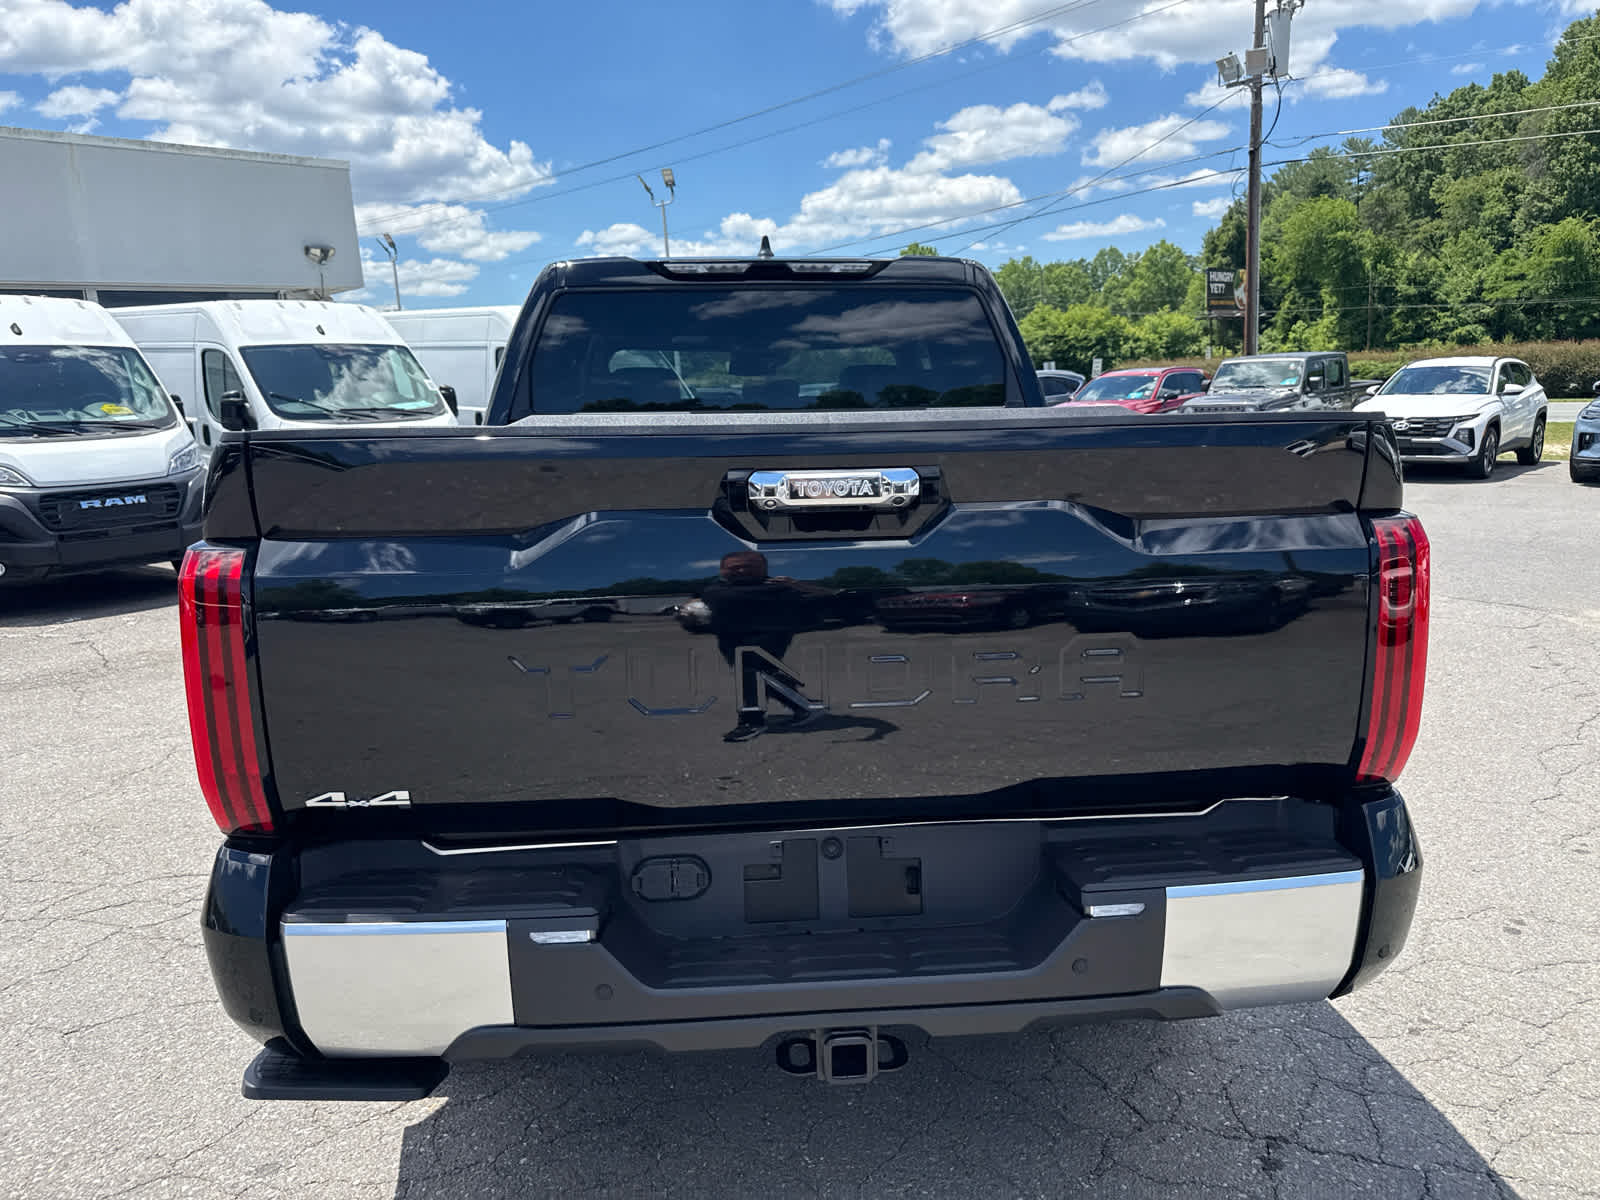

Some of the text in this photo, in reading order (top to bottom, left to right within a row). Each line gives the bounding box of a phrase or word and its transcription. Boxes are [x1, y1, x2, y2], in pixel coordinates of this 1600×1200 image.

[1209, 271, 1234, 282] HUNGRY
[794, 479, 874, 497] TOYOTA
[79, 495, 147, 509] RAM
[508, 633, 1144, 719] TUNDRA
